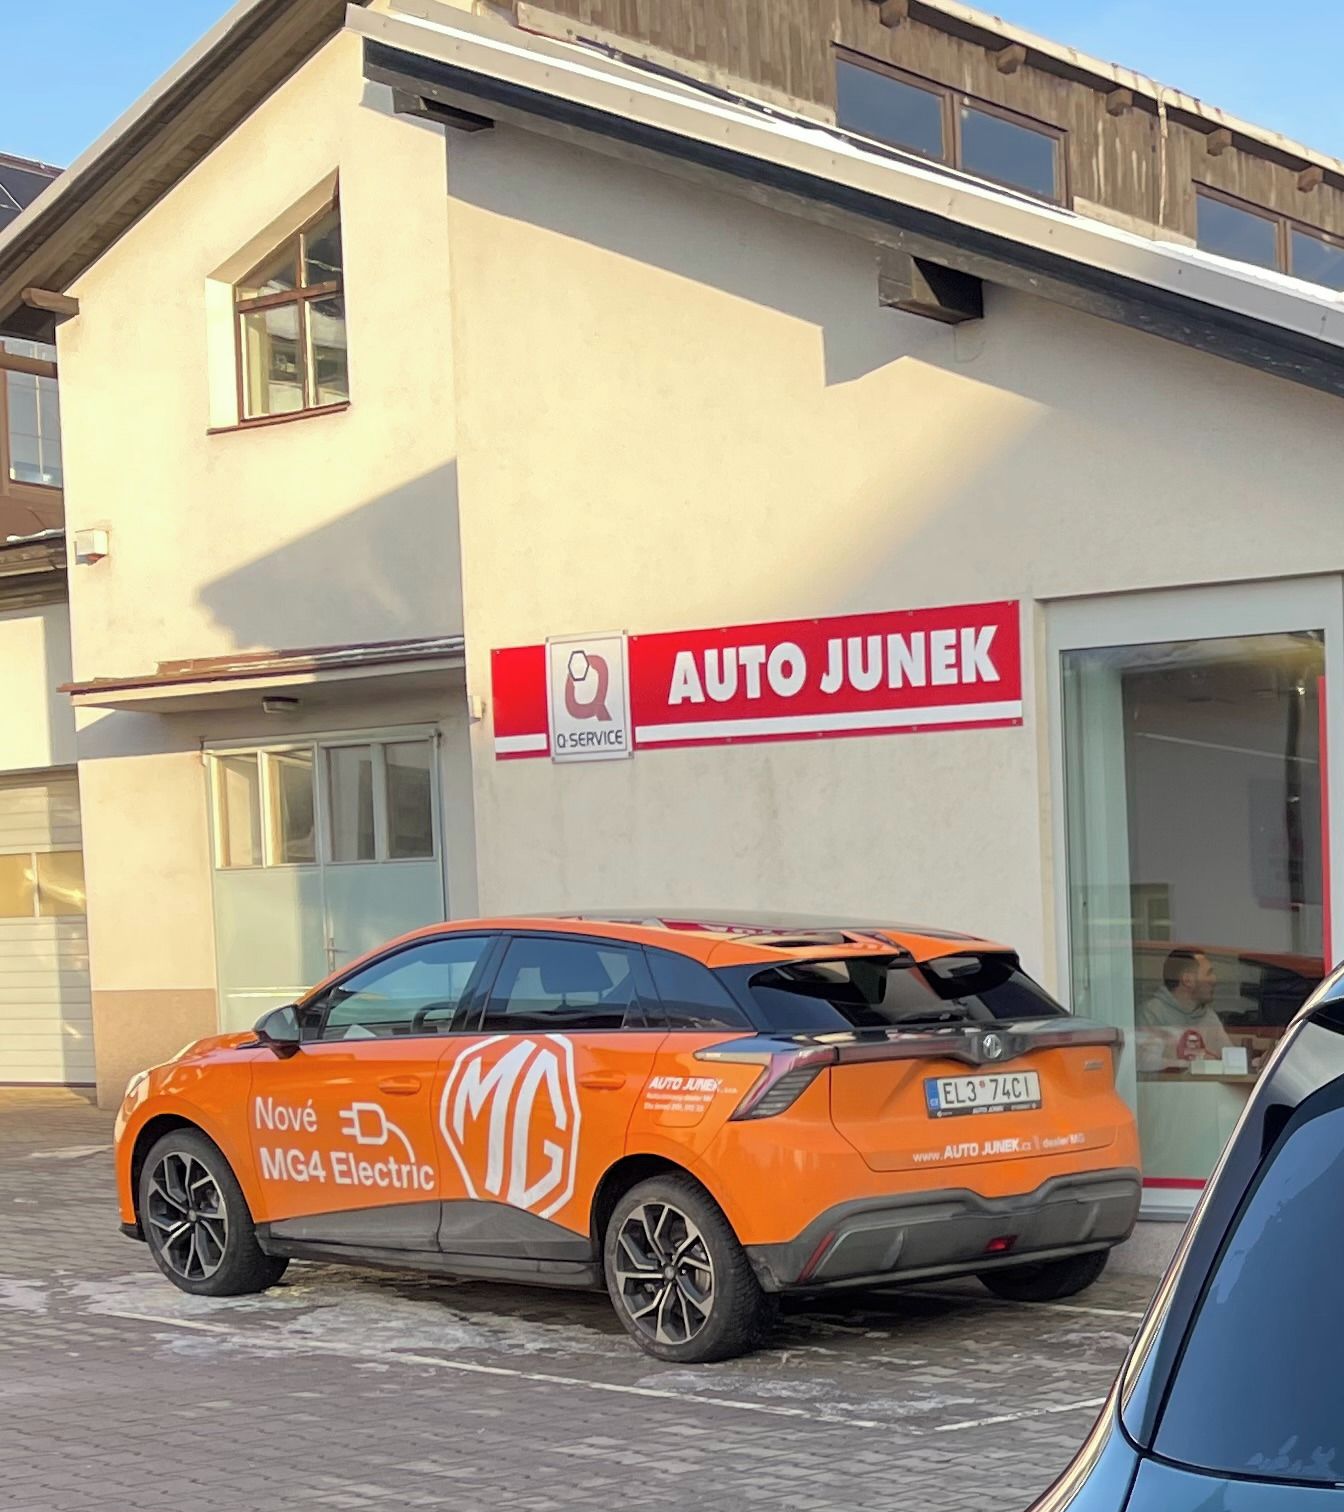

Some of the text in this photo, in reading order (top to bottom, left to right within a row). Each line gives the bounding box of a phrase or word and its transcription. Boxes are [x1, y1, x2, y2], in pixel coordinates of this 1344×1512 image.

[668, 625, 1001, 705] AUTO JUNEK
[648, 1076, 682, 1090] AUTO
[682, 1077, 724, 1092] JUNEK
[942, 1080, 977, 1105] EL3
[255, 1095, 318, 1133] Nové
[450, 1038, 570, 1209] MG
[259, 1147, 436, 1192] MG4 Electric
